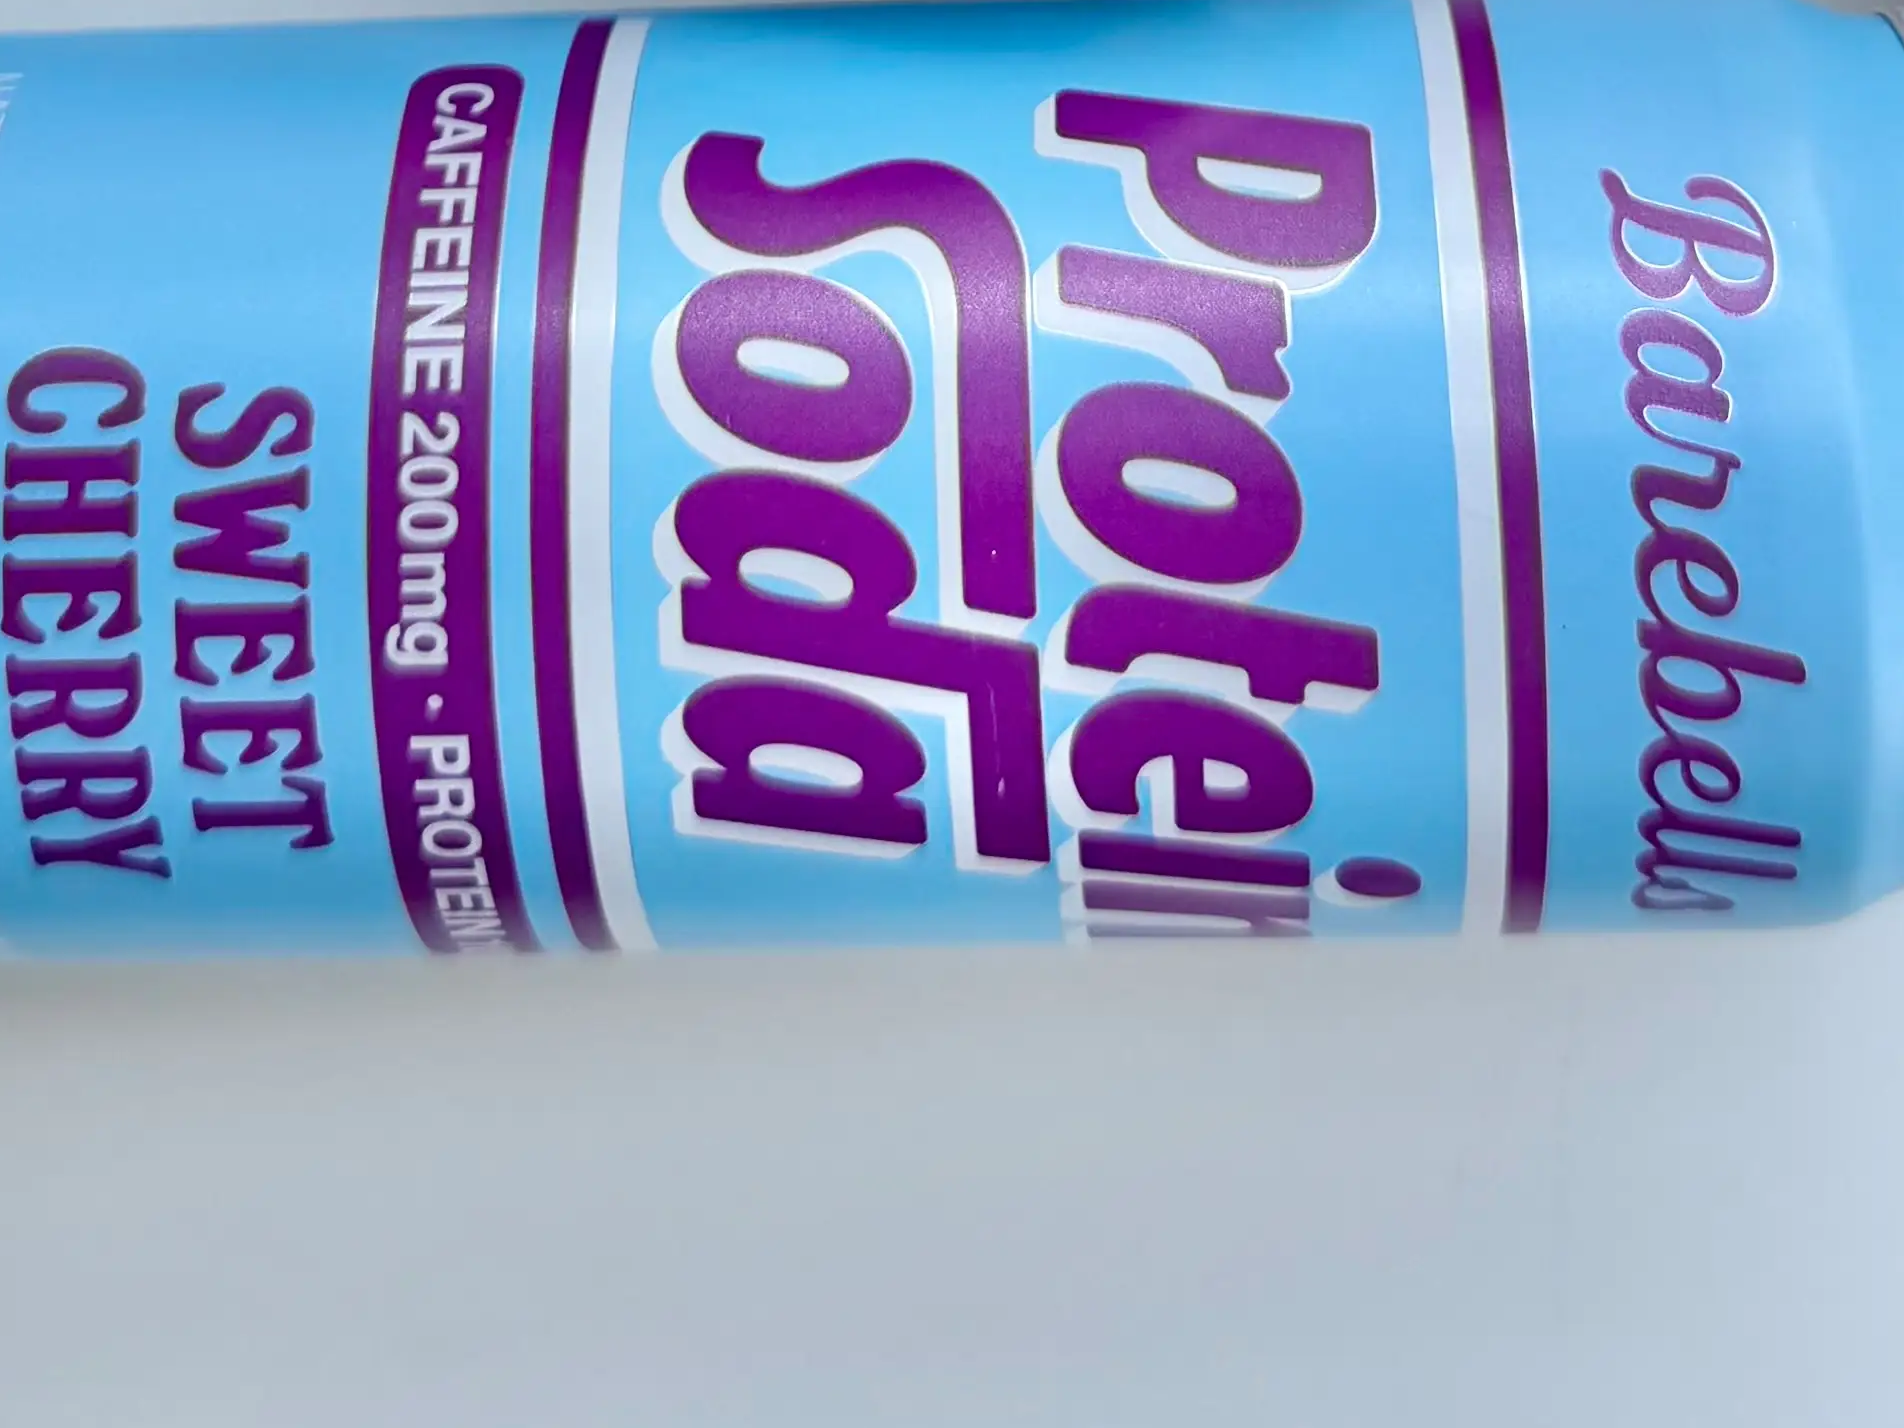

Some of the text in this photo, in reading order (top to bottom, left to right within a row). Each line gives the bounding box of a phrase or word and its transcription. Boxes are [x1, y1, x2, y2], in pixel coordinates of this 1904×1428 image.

[0, 346, 173, 881] CHERRY
[173, 382, 335, 852] SWEET
[384, 80, 507, 940] CAFFEINE 200mg PROTEIN
[652, 130, 1051, 876] Soda
[1034, 89, 1422, 941] Protein
[1597, 166, 1807, 913] Barebells
